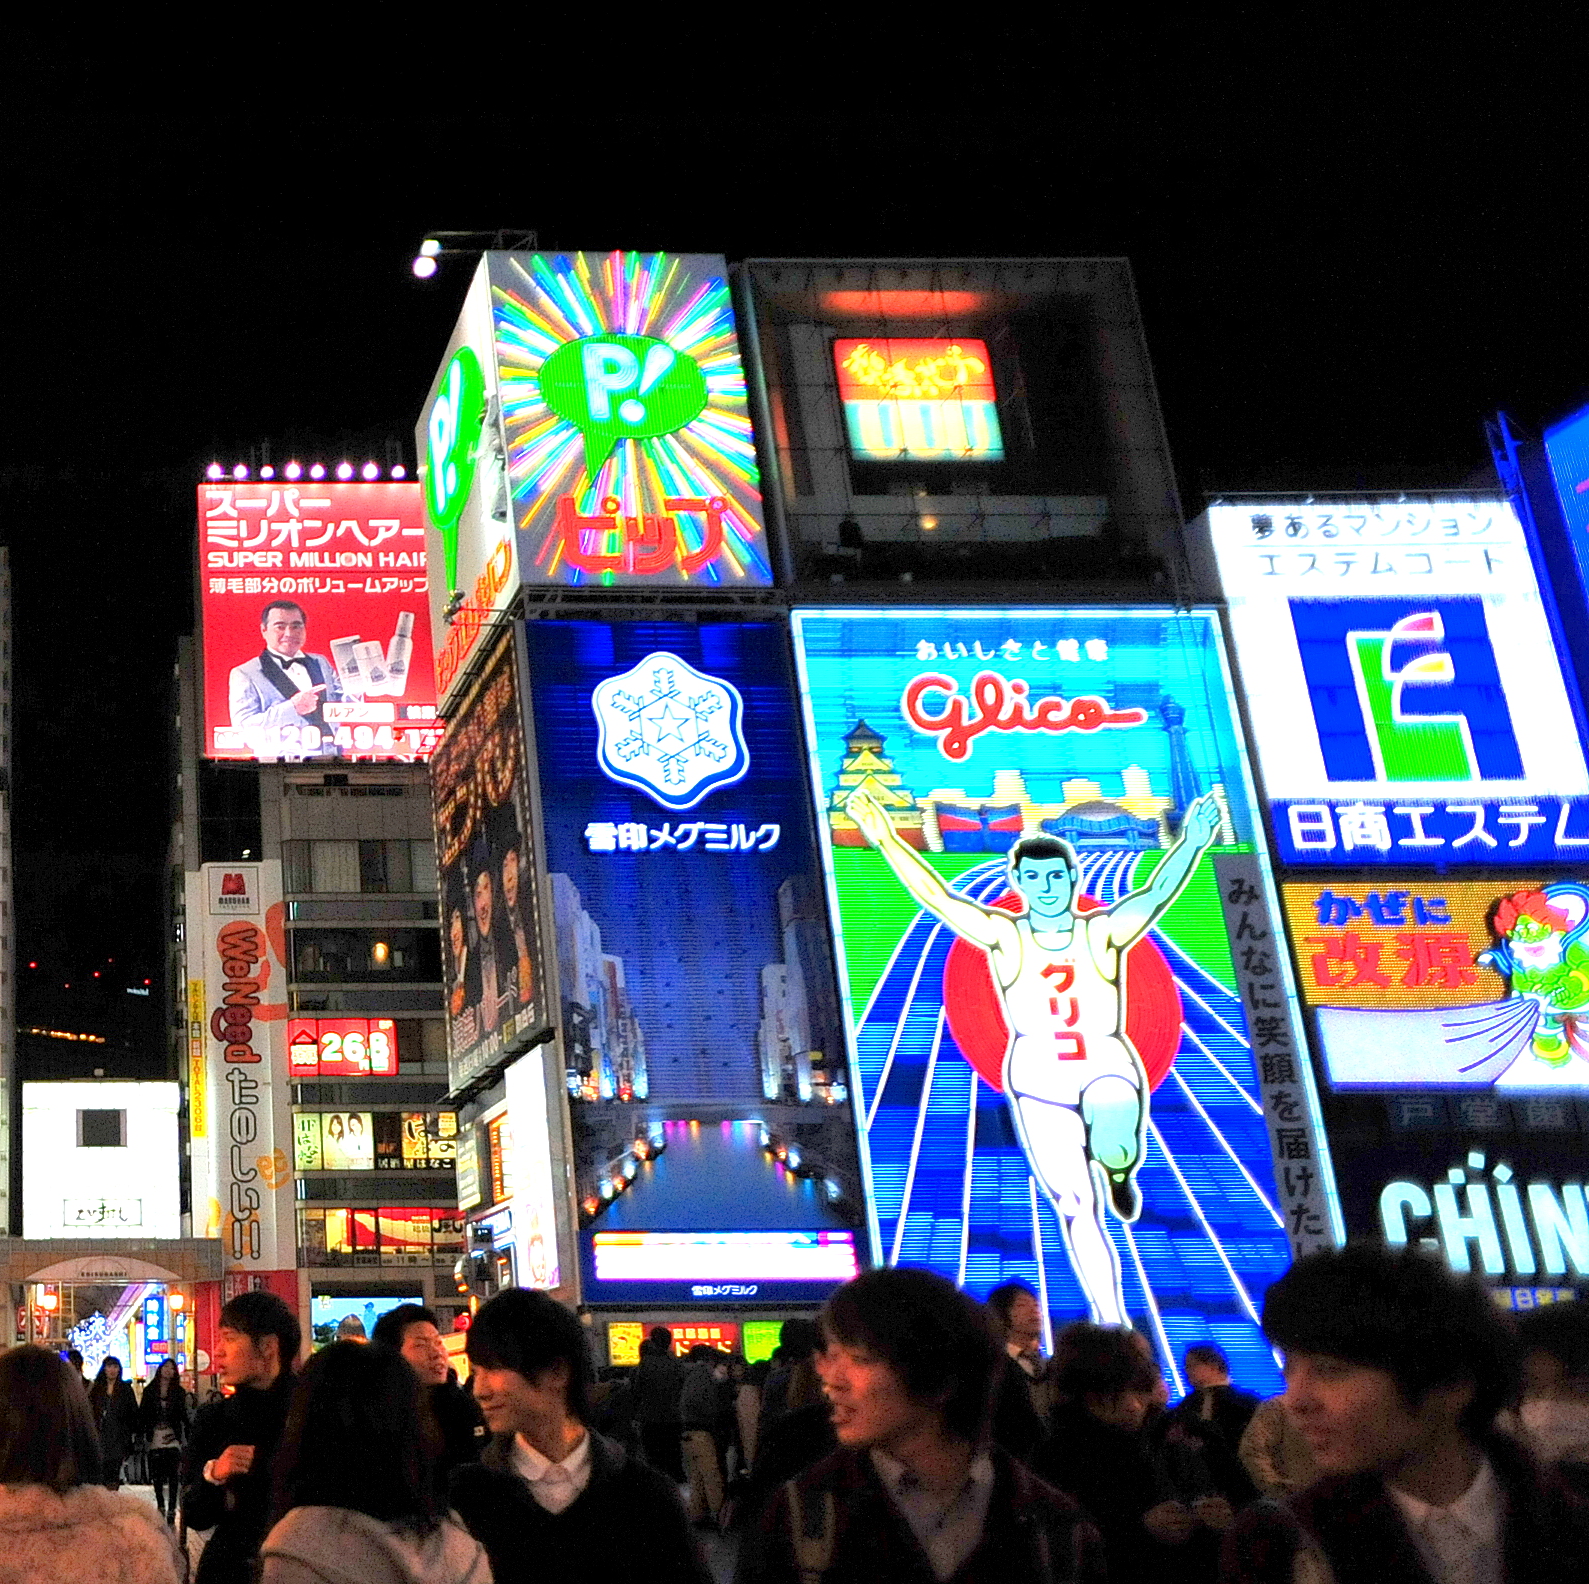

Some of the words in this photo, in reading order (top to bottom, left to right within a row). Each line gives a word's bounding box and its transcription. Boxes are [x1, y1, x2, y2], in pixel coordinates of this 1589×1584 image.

[582, 341, 675, 423] P!
[205, 488, 331, 517] スーパー
[206, 519, 425, 549] ミリオンヘアー
[557, 494, 730, 574] ピップ
[1251, 513, 1492, 540] 夢あるマンション
[207, 551, 283, 568] SUPER
[289, 551, 373, 568] MILLION
[1258, 549, 1505, 577] エステムコート
[916, 638, 1109, 663] おいしさと健康
[901, 671, 1148, 761] Glico
[584, 822, 781, 851] 雪印メグミルク
[1313, 889, 1452, 928] かぜに
[1304, 932, 1482, 989] 改源
[1040, 957, 1088, 1061] グリコ
[1380, 1180, 1589, 1275] CHIN
